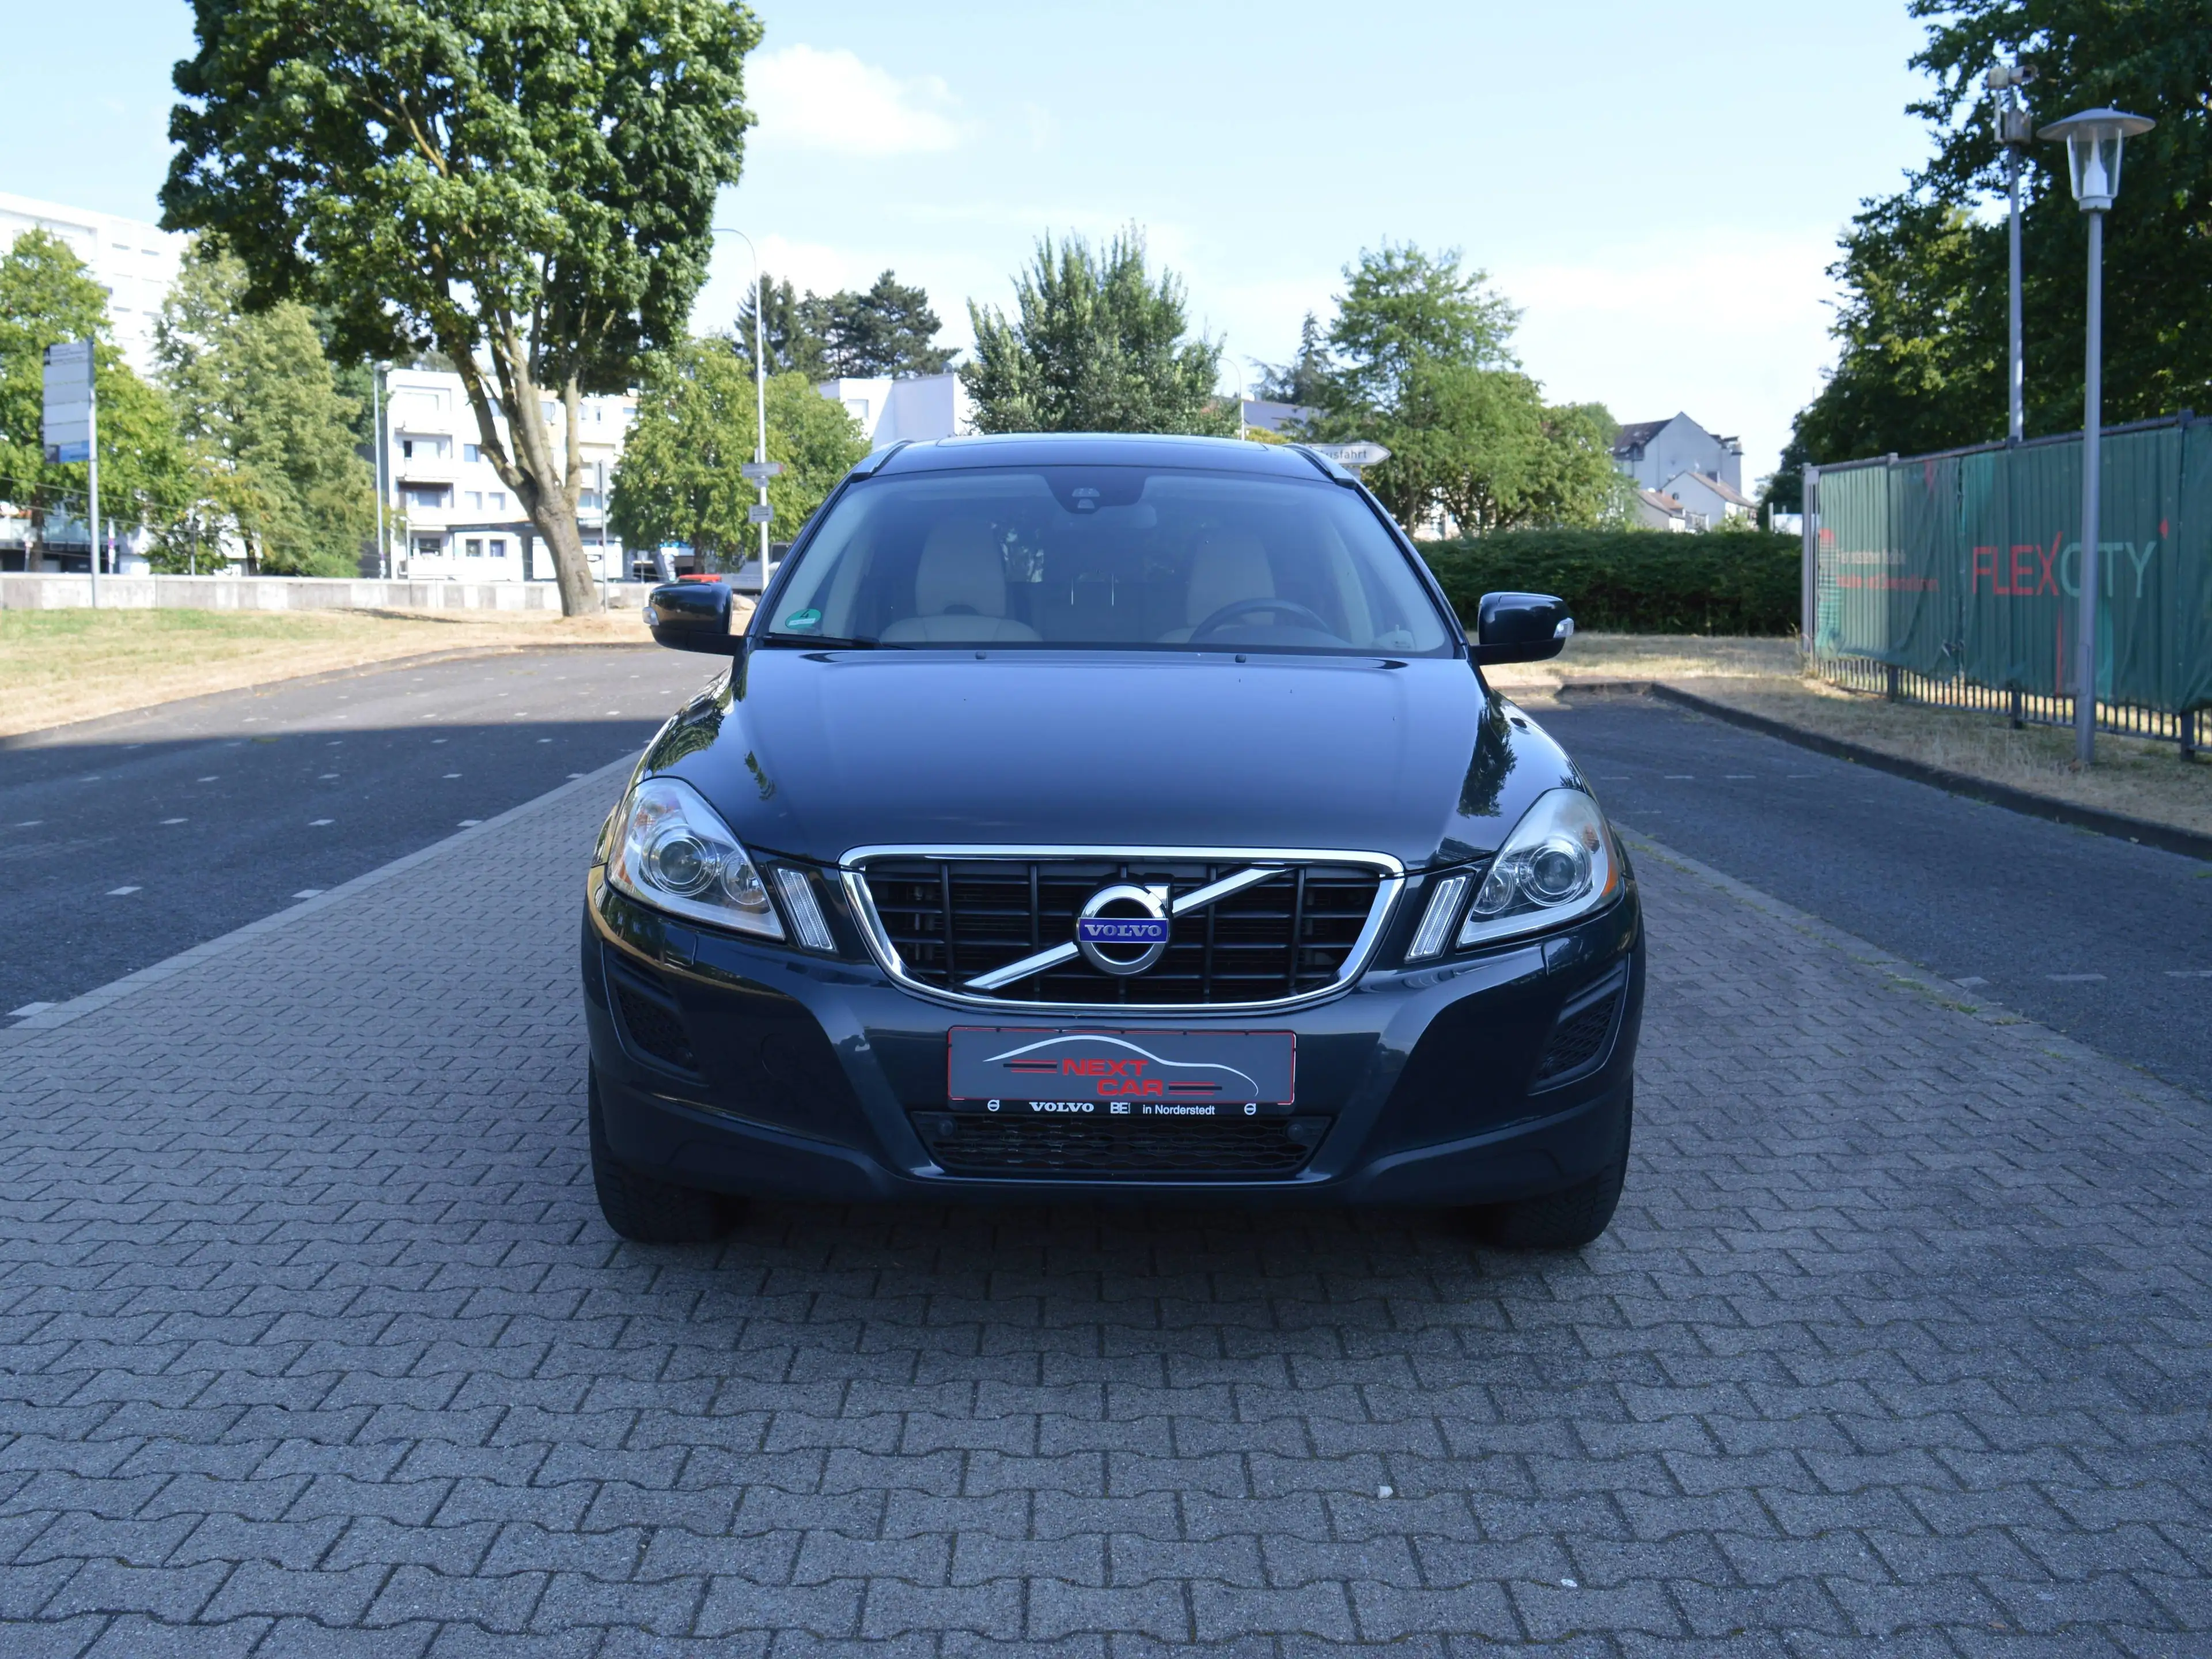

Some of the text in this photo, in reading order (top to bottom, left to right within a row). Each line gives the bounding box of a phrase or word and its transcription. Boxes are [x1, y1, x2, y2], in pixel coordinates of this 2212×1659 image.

[1320, 449, 1367, 460] usfahrt
[1972, 531, 2157, 599] FLEXCTY
[800, 609, 810, 619] 4
[1084, 924, 1162, 937] VOLVO
[1062, 1058, 1149, 1077] NEXT
[1097, 1078, 1163, 1096] CAR
[1029, 1101, 1094, 1112] VOLVO
[1143, 1104, 1152, 1115] in
[1155, 1104, 1215, 1115] Norderstedt
